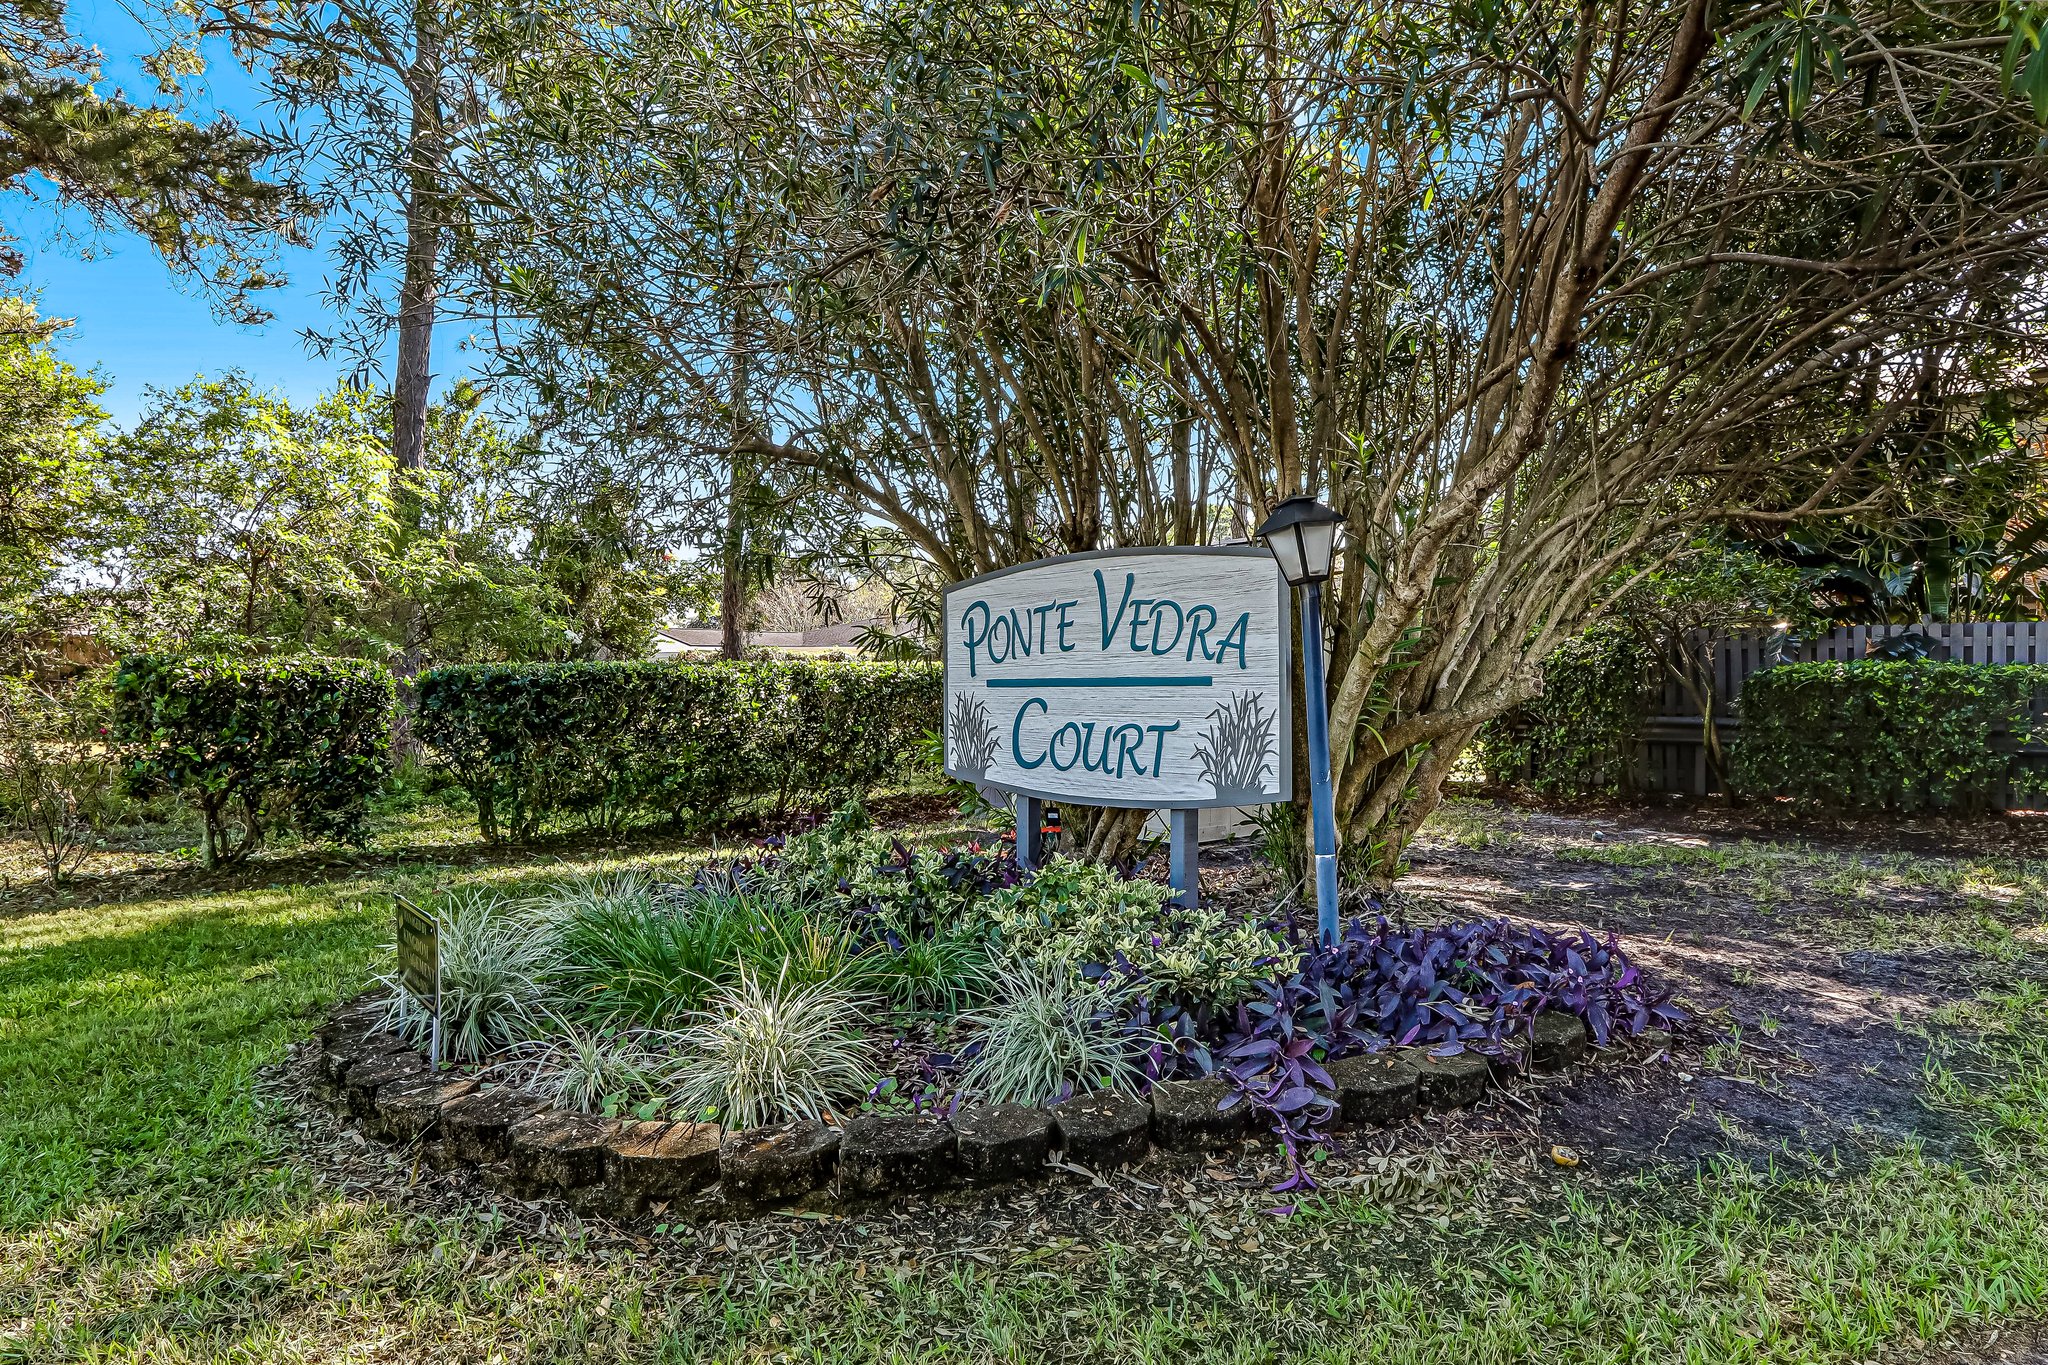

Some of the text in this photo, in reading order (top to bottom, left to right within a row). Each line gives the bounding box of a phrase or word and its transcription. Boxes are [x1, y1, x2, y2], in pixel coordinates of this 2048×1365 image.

[961, 568, 1251, 678] PONTE VEDRA
[1011, 697, 1181, 779] COURT
